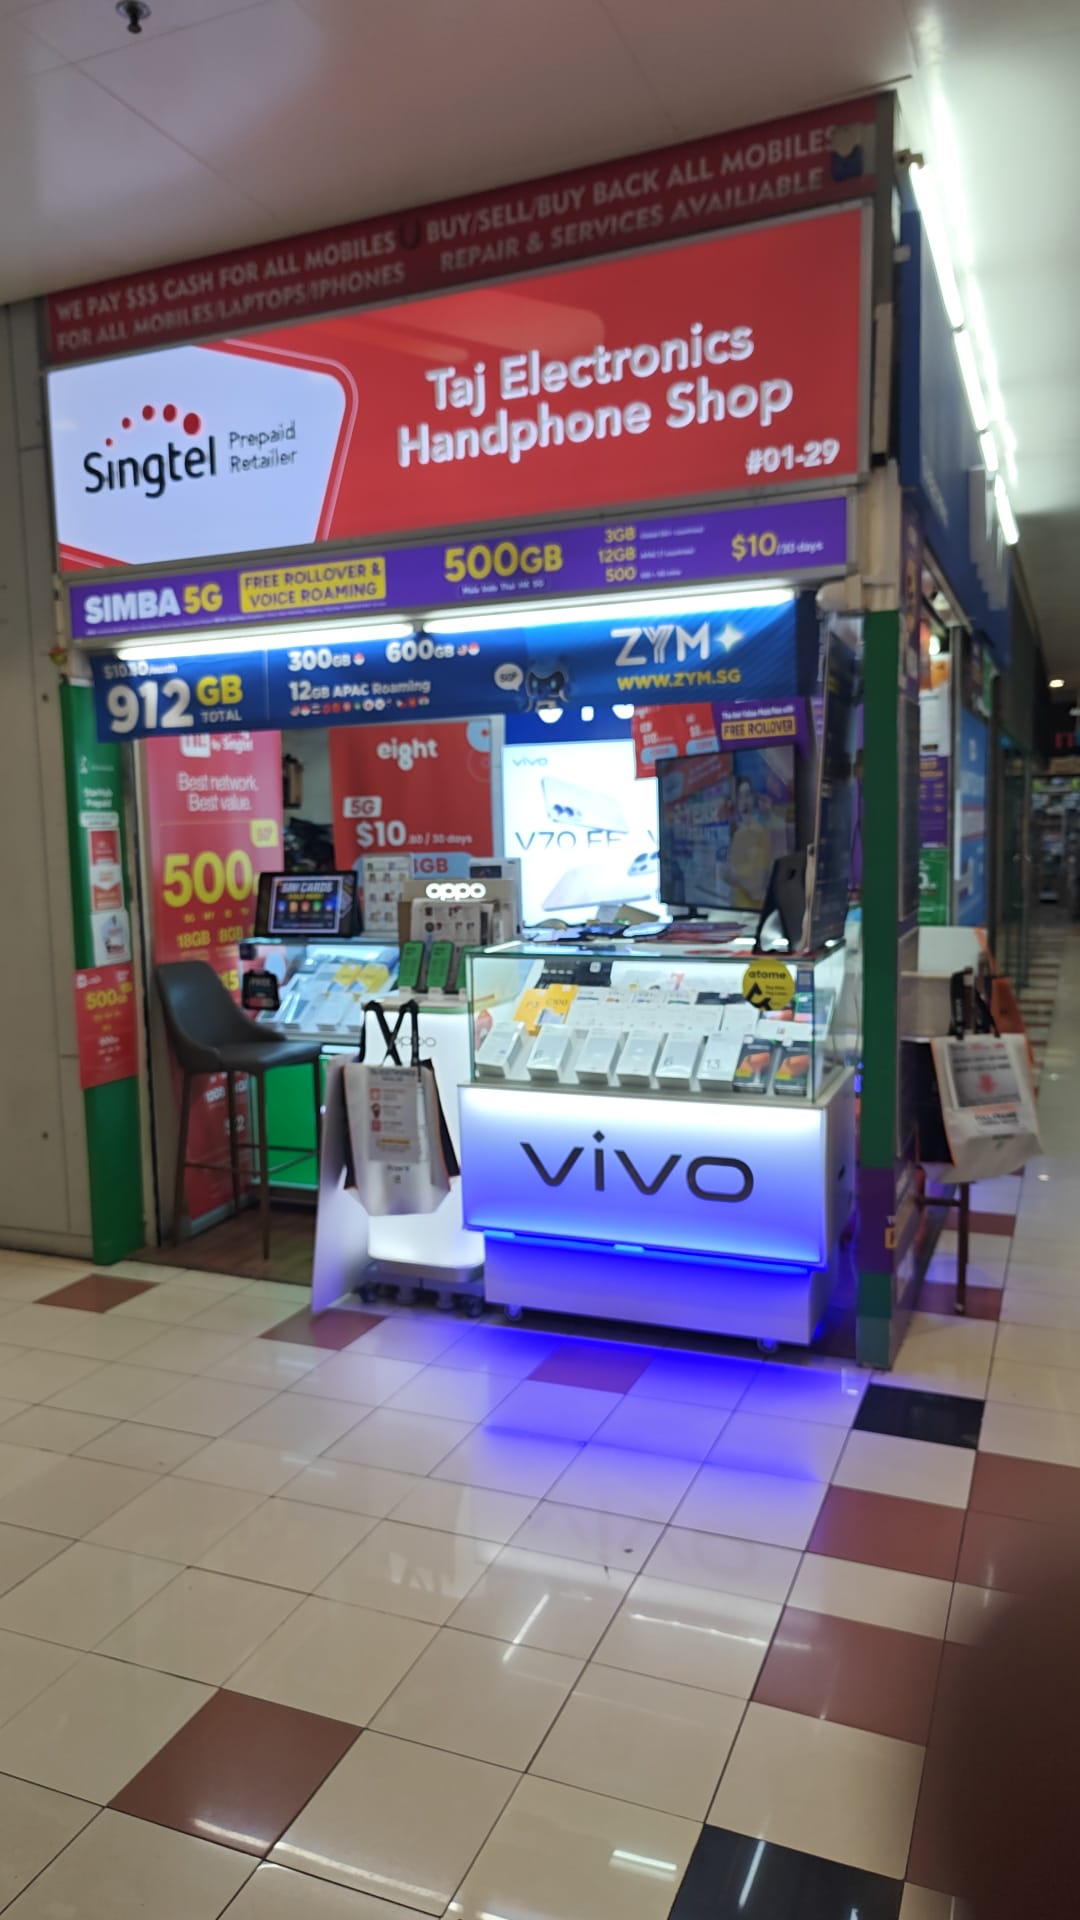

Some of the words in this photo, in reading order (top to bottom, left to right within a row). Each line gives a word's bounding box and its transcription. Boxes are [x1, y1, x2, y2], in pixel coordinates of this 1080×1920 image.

[426, 187, 585, 244] BUY/SELL/BUY
[593, 169, 661, 203] BACK
[666, 156, 714, 189] ALL
[440, 235, 518, 273] REPAIR
[526, 231, 542, 254] &
[550, 203, 664, 250] SERVICES
[670, 167, 825, 222] AVAILIABLE
[55, 300, 82, 321] WE
[88, 294, 123, 316] PAY
[162, 273, 214, 302] CASH
[219, 264, 259, 290] FOR
[263, 256, 299, 280] ALL
[304, 230, 397, 271] MOBILES
[55, 325, 91, 351] FOR
[95, 319, 127, 343] ALL
[426, 362, 486, 418] Taj
[498, 321, 756, 401] Electronics
[398, 400, 652, 468] Handphone
[665, 376, 794, 427] Shop
[229, 420, 297, 452] Prepaid
[83, 435, 217, 499] Singtel
[230, 448, 298, 474] Retailer
[745, 438, 840, 475] #01-29
[604, 526, 637, 544] 3GB
[444, 539, 564, 583] 500GB
[597, 546, 637, 565] 12GB
[245, 569, 280, 588] FREE
[285, 563, 367, 586] ROLLOVER
[370, 561, 381, 576] &
[605, 566, 637, 583] 500
[84, 586, 181, 625] SIMBA
[184, 582, 224, 614] 5G
[250, 589, 295, 608] VOICE
[300, 581, 378, 601] ROAMING
[385, 639, 455, 663] 600GB
[610, 622, 710, 667] ZYM
[287, 647, 351, 672] 300GB
[288, 680, 330, 703] 12GB
[332, 683, 370, 699] APAC
[372, 679, 432, 698] Roaming
[617, 668, 742, 691] WWW.ZYM.SG
[107, 678, 195, 734] 912
[196, 674, 243, 707] GB
[201, 708, 243, 724] TOTAL
[723, 723, 746, 738] FREE
[749, 719, 793, 736] ROLLOVER
[376, 737, 438, 771] eight
[511, 756, 548, 768] vivo
[176, 772, 209, 792] Best
[187, 794, 218, 812] Best
[350, 802, 376, 815] 5G
[446, 833, 473, 846] days
[425, 882, 487, 902] oppo
[748, 968, 788, 982] atome
[520, 1130, 755, 1203] vivo
